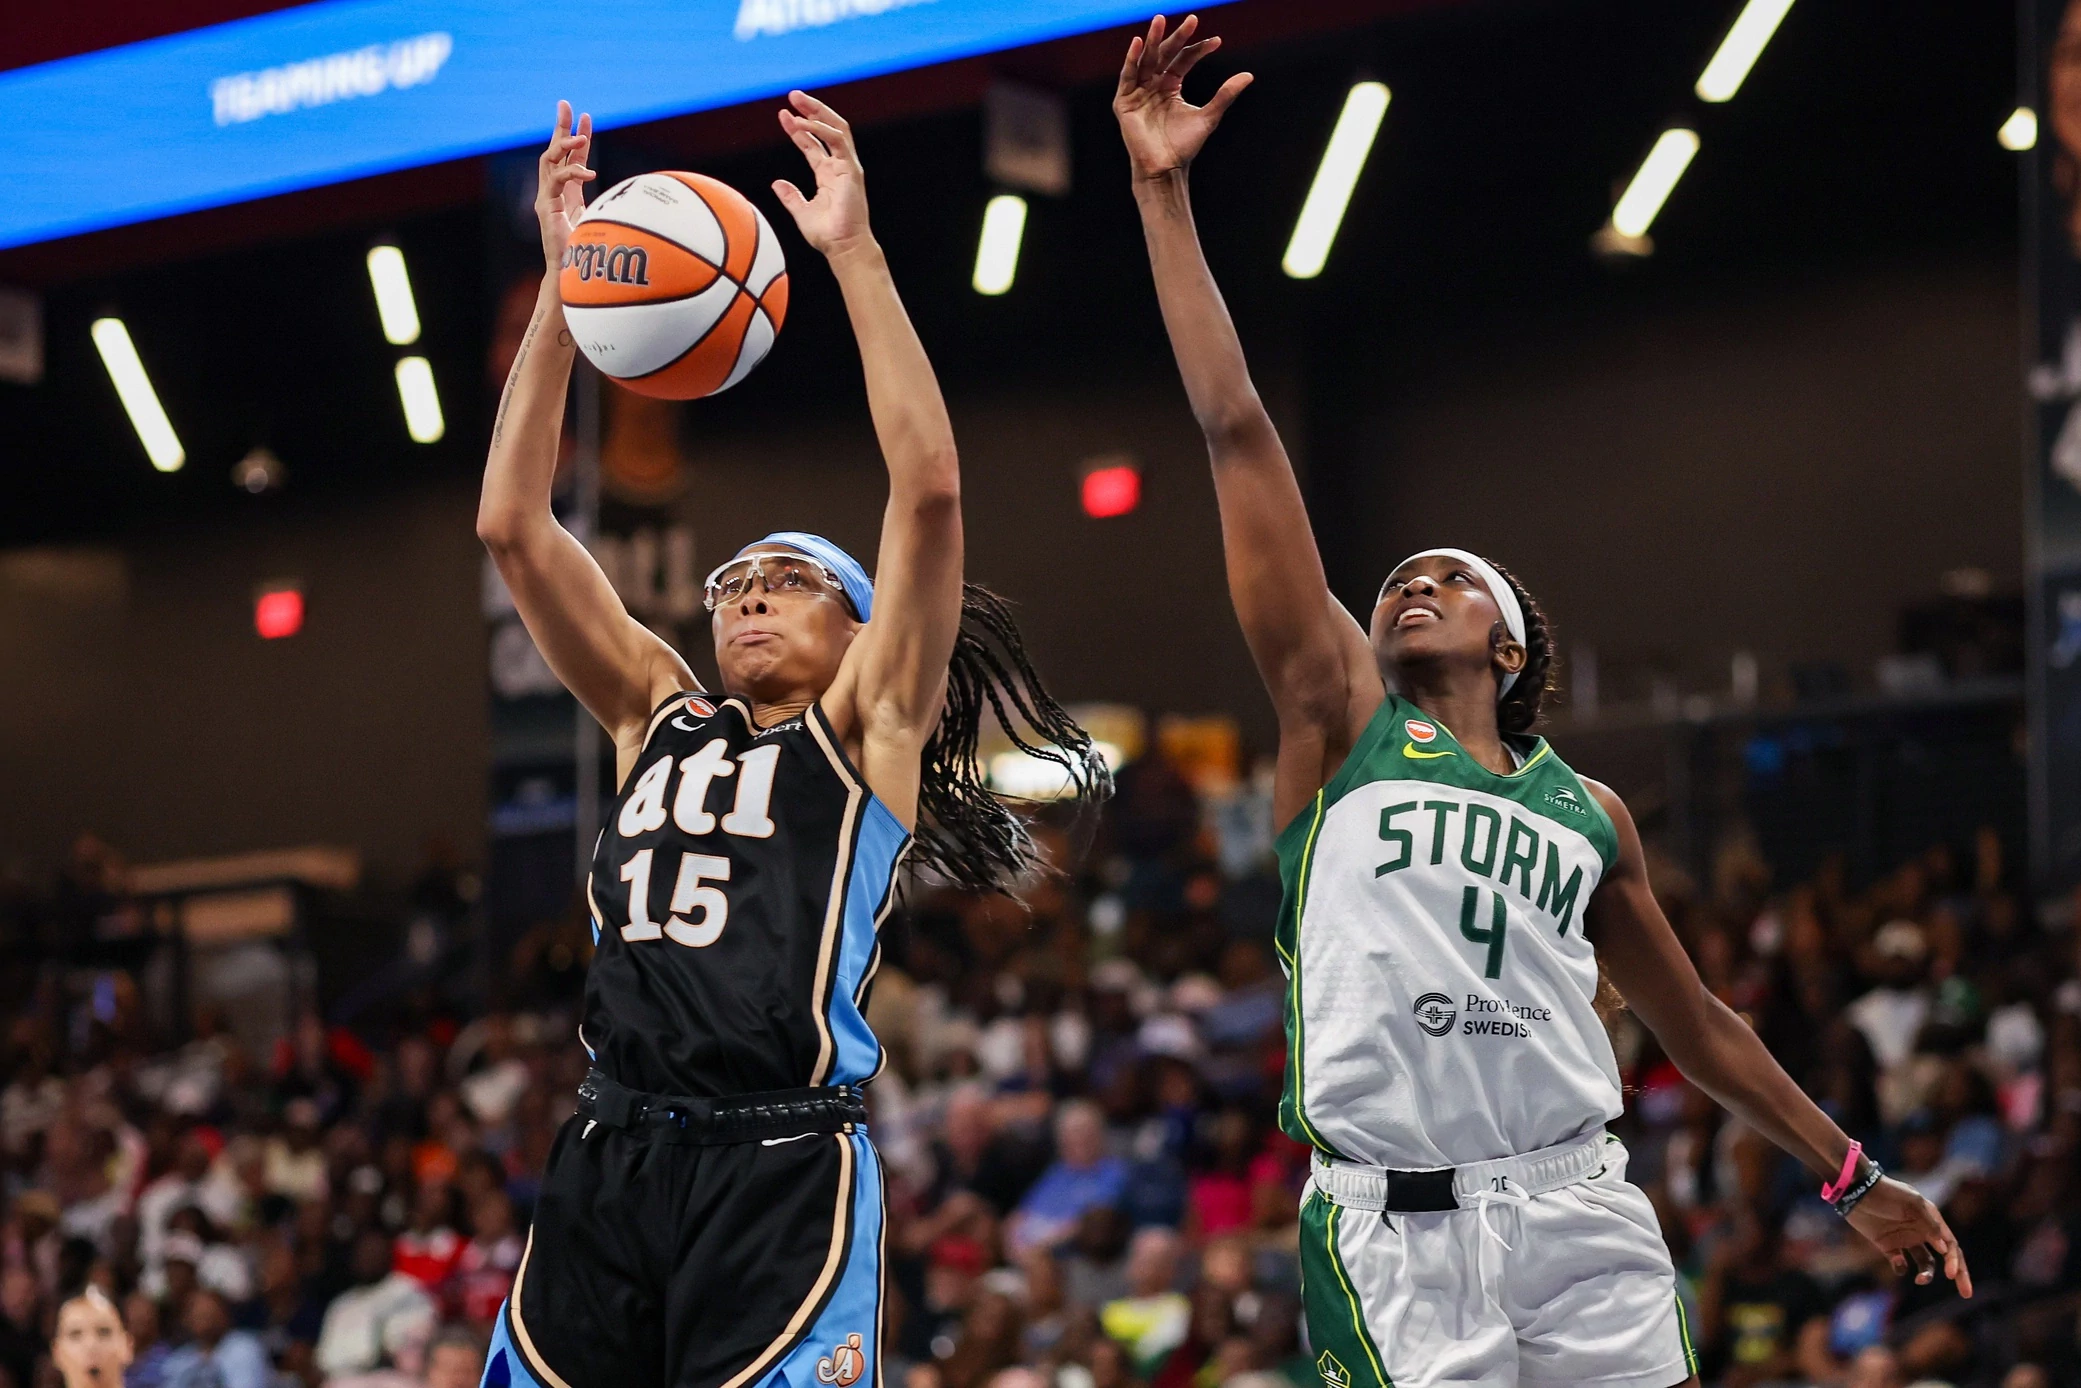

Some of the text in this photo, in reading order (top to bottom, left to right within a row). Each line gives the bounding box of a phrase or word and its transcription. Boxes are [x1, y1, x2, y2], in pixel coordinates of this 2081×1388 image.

[562, 243, 650, 287] Wilso
[617, 738, 781, 839] atl
[1544, 793, 1587, 816] SYMETRA
[619, 848, 731, 948] 15
[1375, 799, 1584, 938] STORM
[1459, 885, 1507, 980] 4
[1463, 1020, 1532, 1038] SWEDIS
